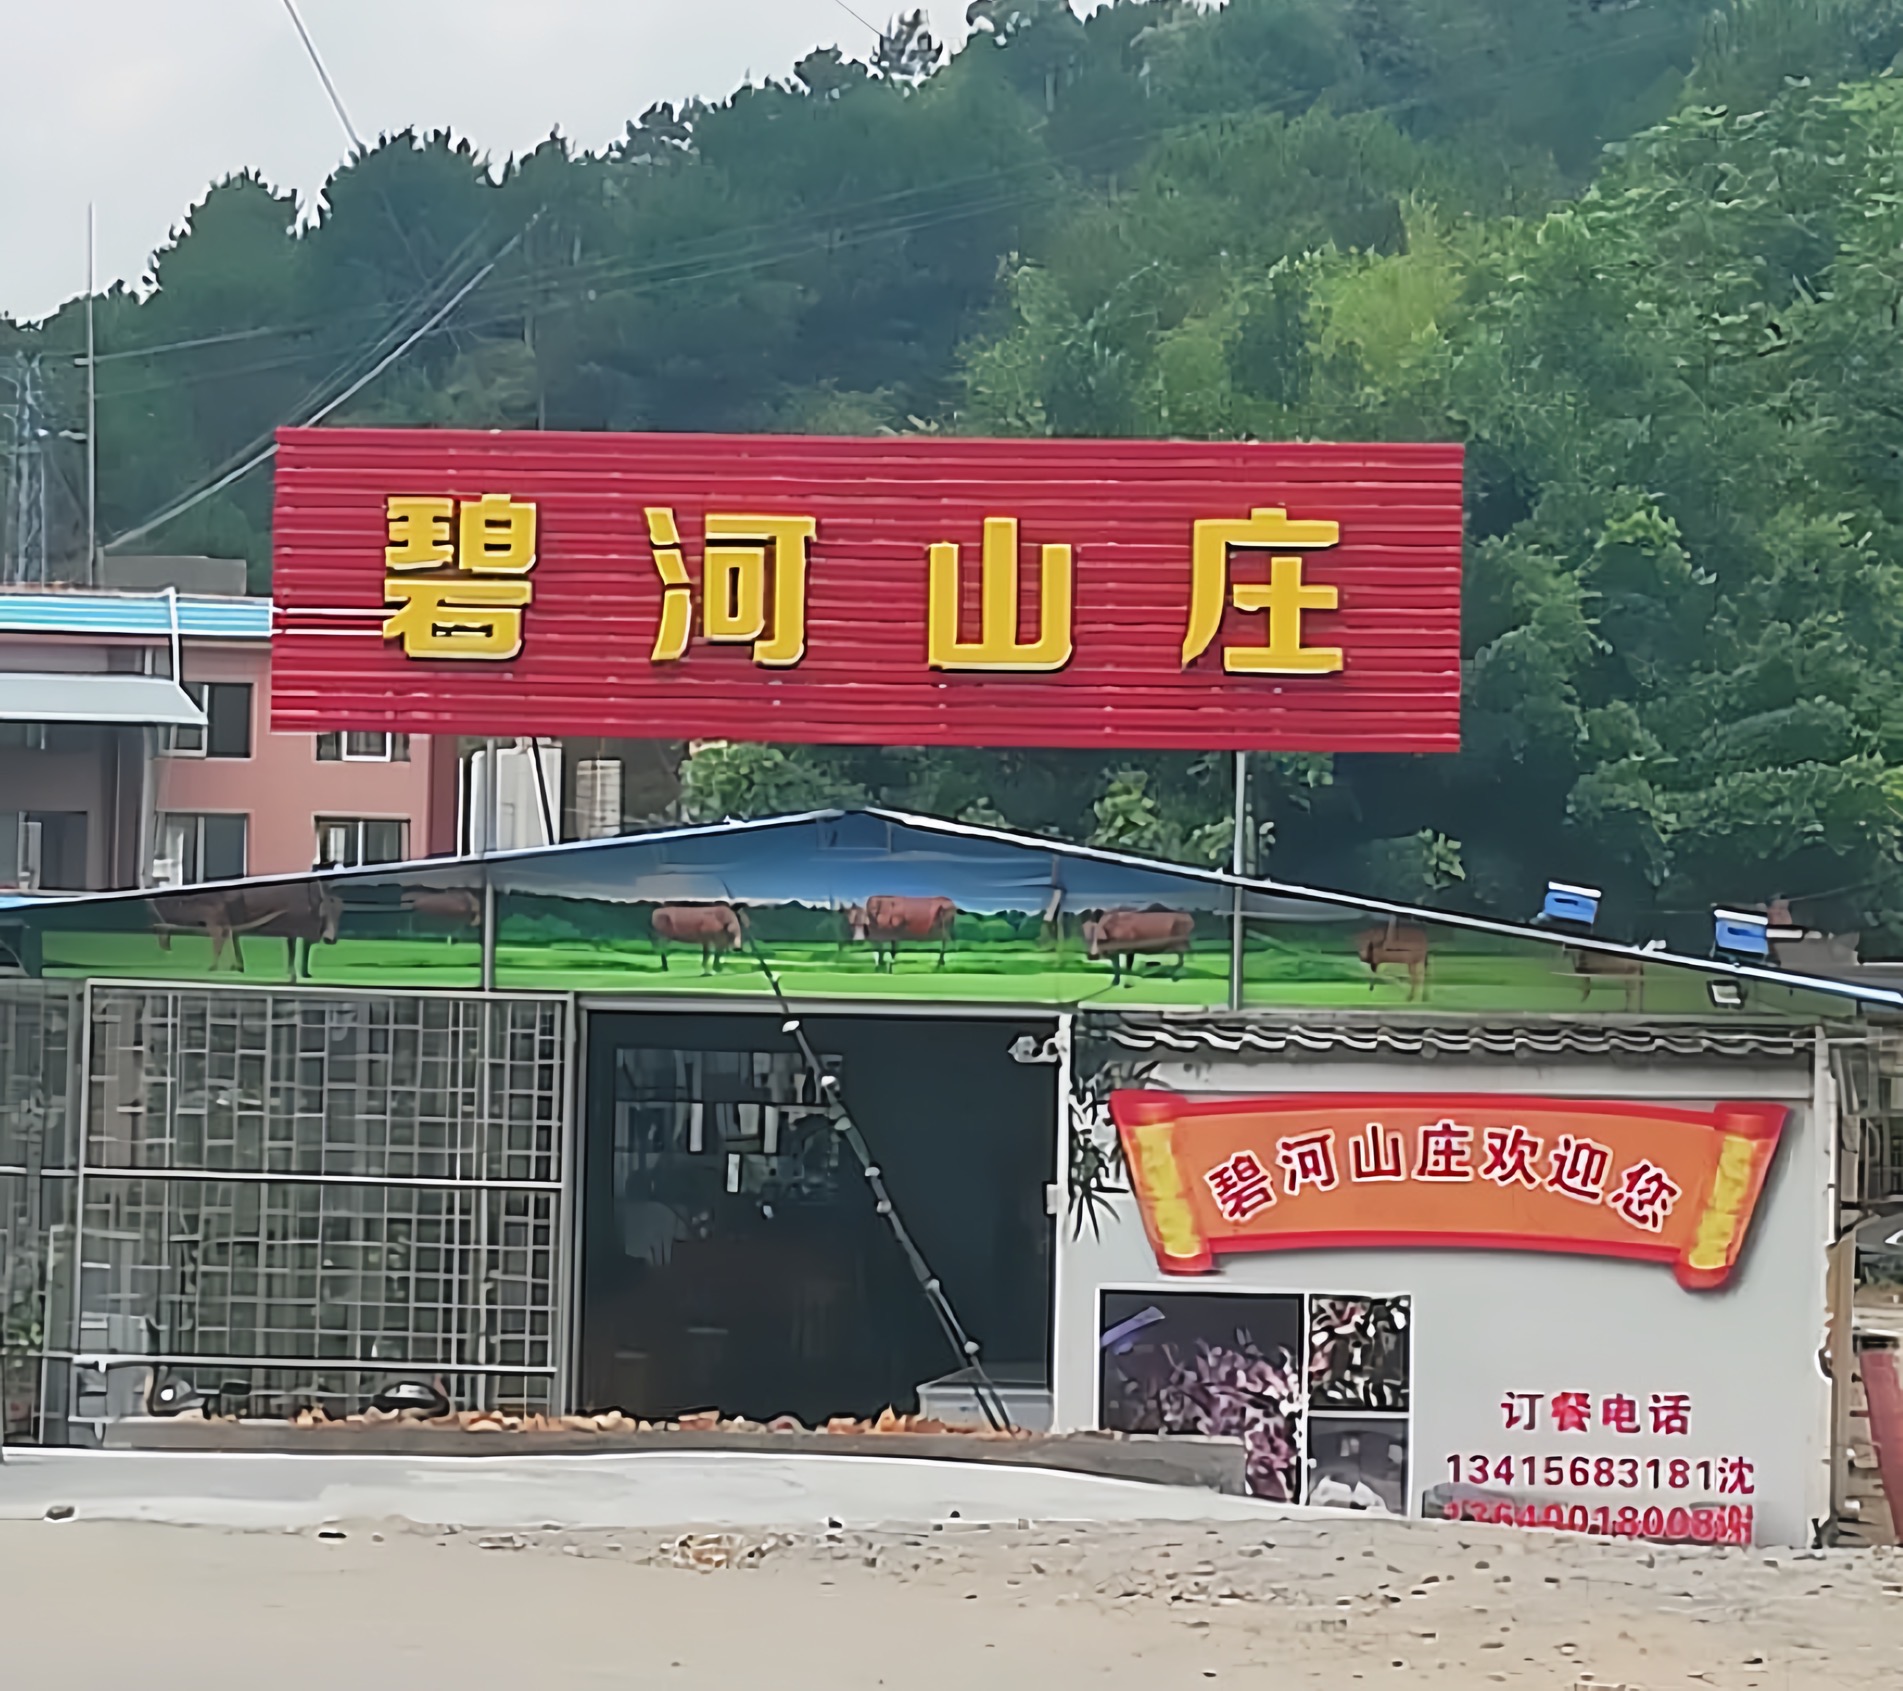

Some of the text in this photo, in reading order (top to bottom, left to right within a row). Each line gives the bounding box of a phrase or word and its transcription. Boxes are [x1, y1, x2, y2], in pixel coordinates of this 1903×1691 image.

[381, 493, 1346, 676] 碧河山庄
[1205, 1122, 1680, 1231] 碧河山庄欢迎您
[1500, 1390, 1692, 1435] 订餐电话
